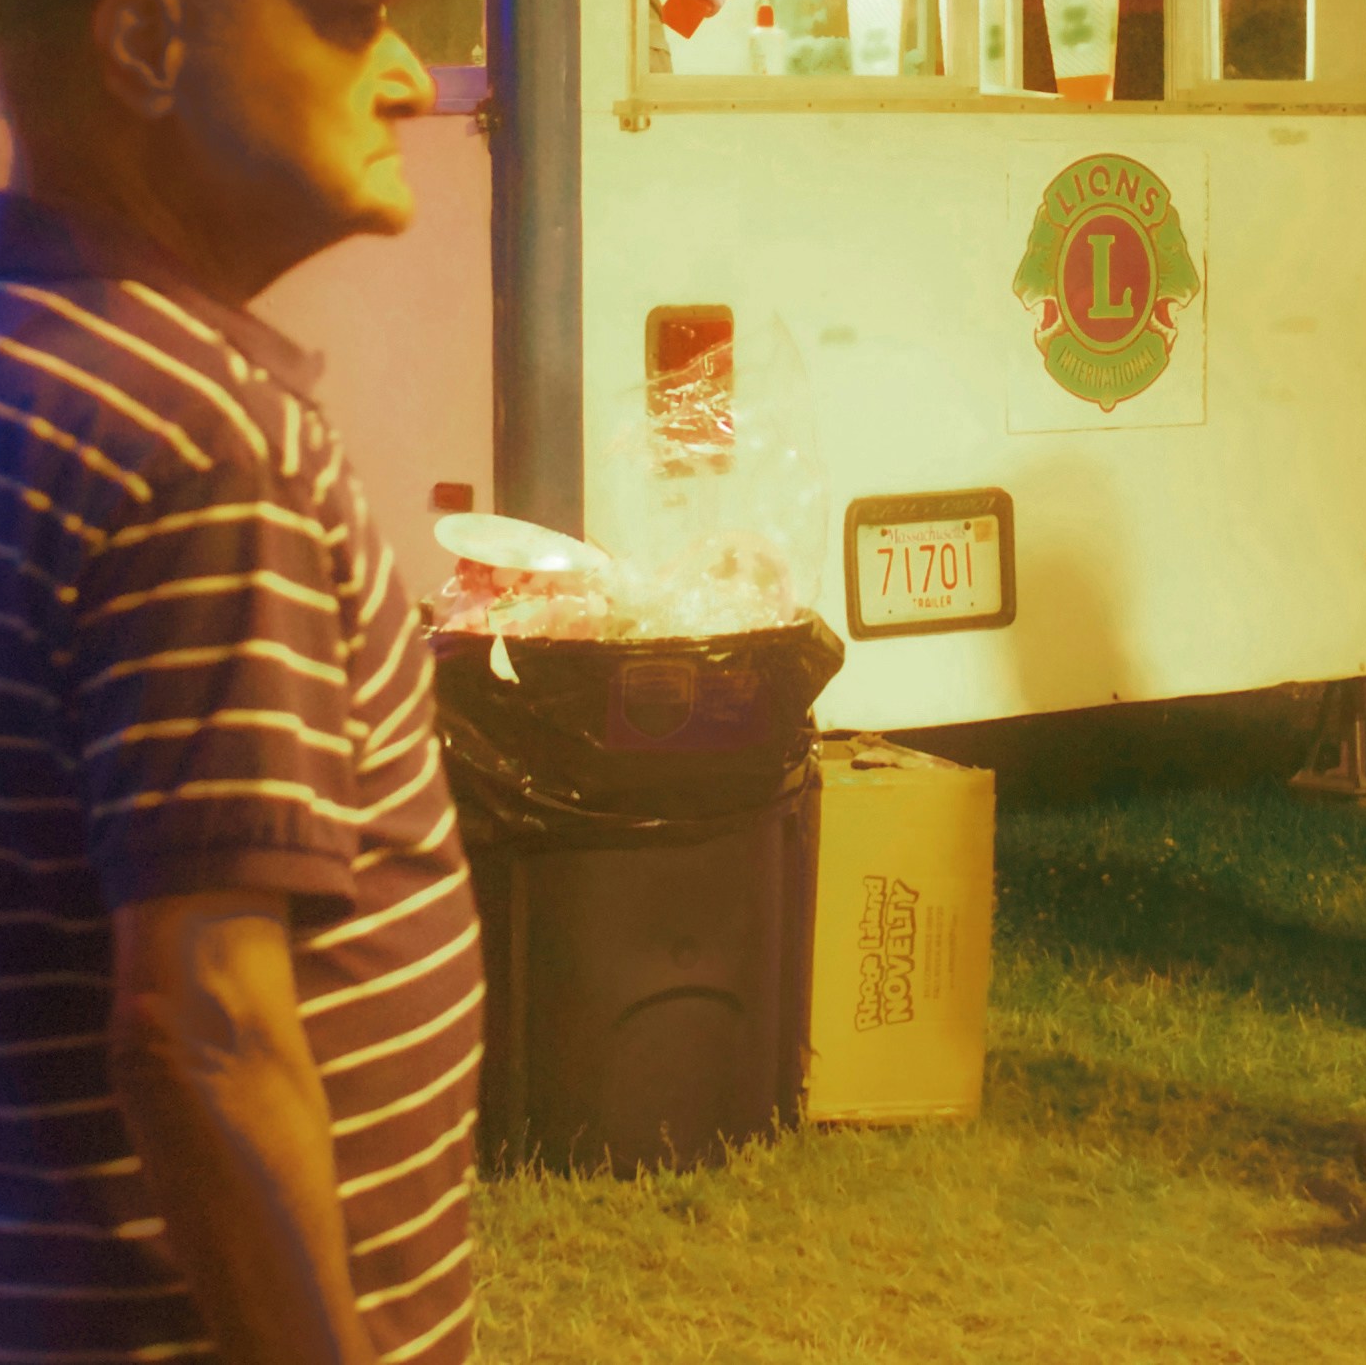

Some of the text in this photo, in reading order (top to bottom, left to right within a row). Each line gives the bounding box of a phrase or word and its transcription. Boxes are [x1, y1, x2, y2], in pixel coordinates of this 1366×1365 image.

[1055, 165, 1160, 217] LIONS
[1087, 234, 1134, 319] L
[1056, 346, 1159, 390] INTERNATIONAL
[887, 525, 967, 544] Massachusetts
[877, 542, 972, 596] 71701
[912, 595, 952, 609] TRAILER
[854, 874, 887, 1033] Rhode Island
[882, 878, 920, 1025] NOVELTY
